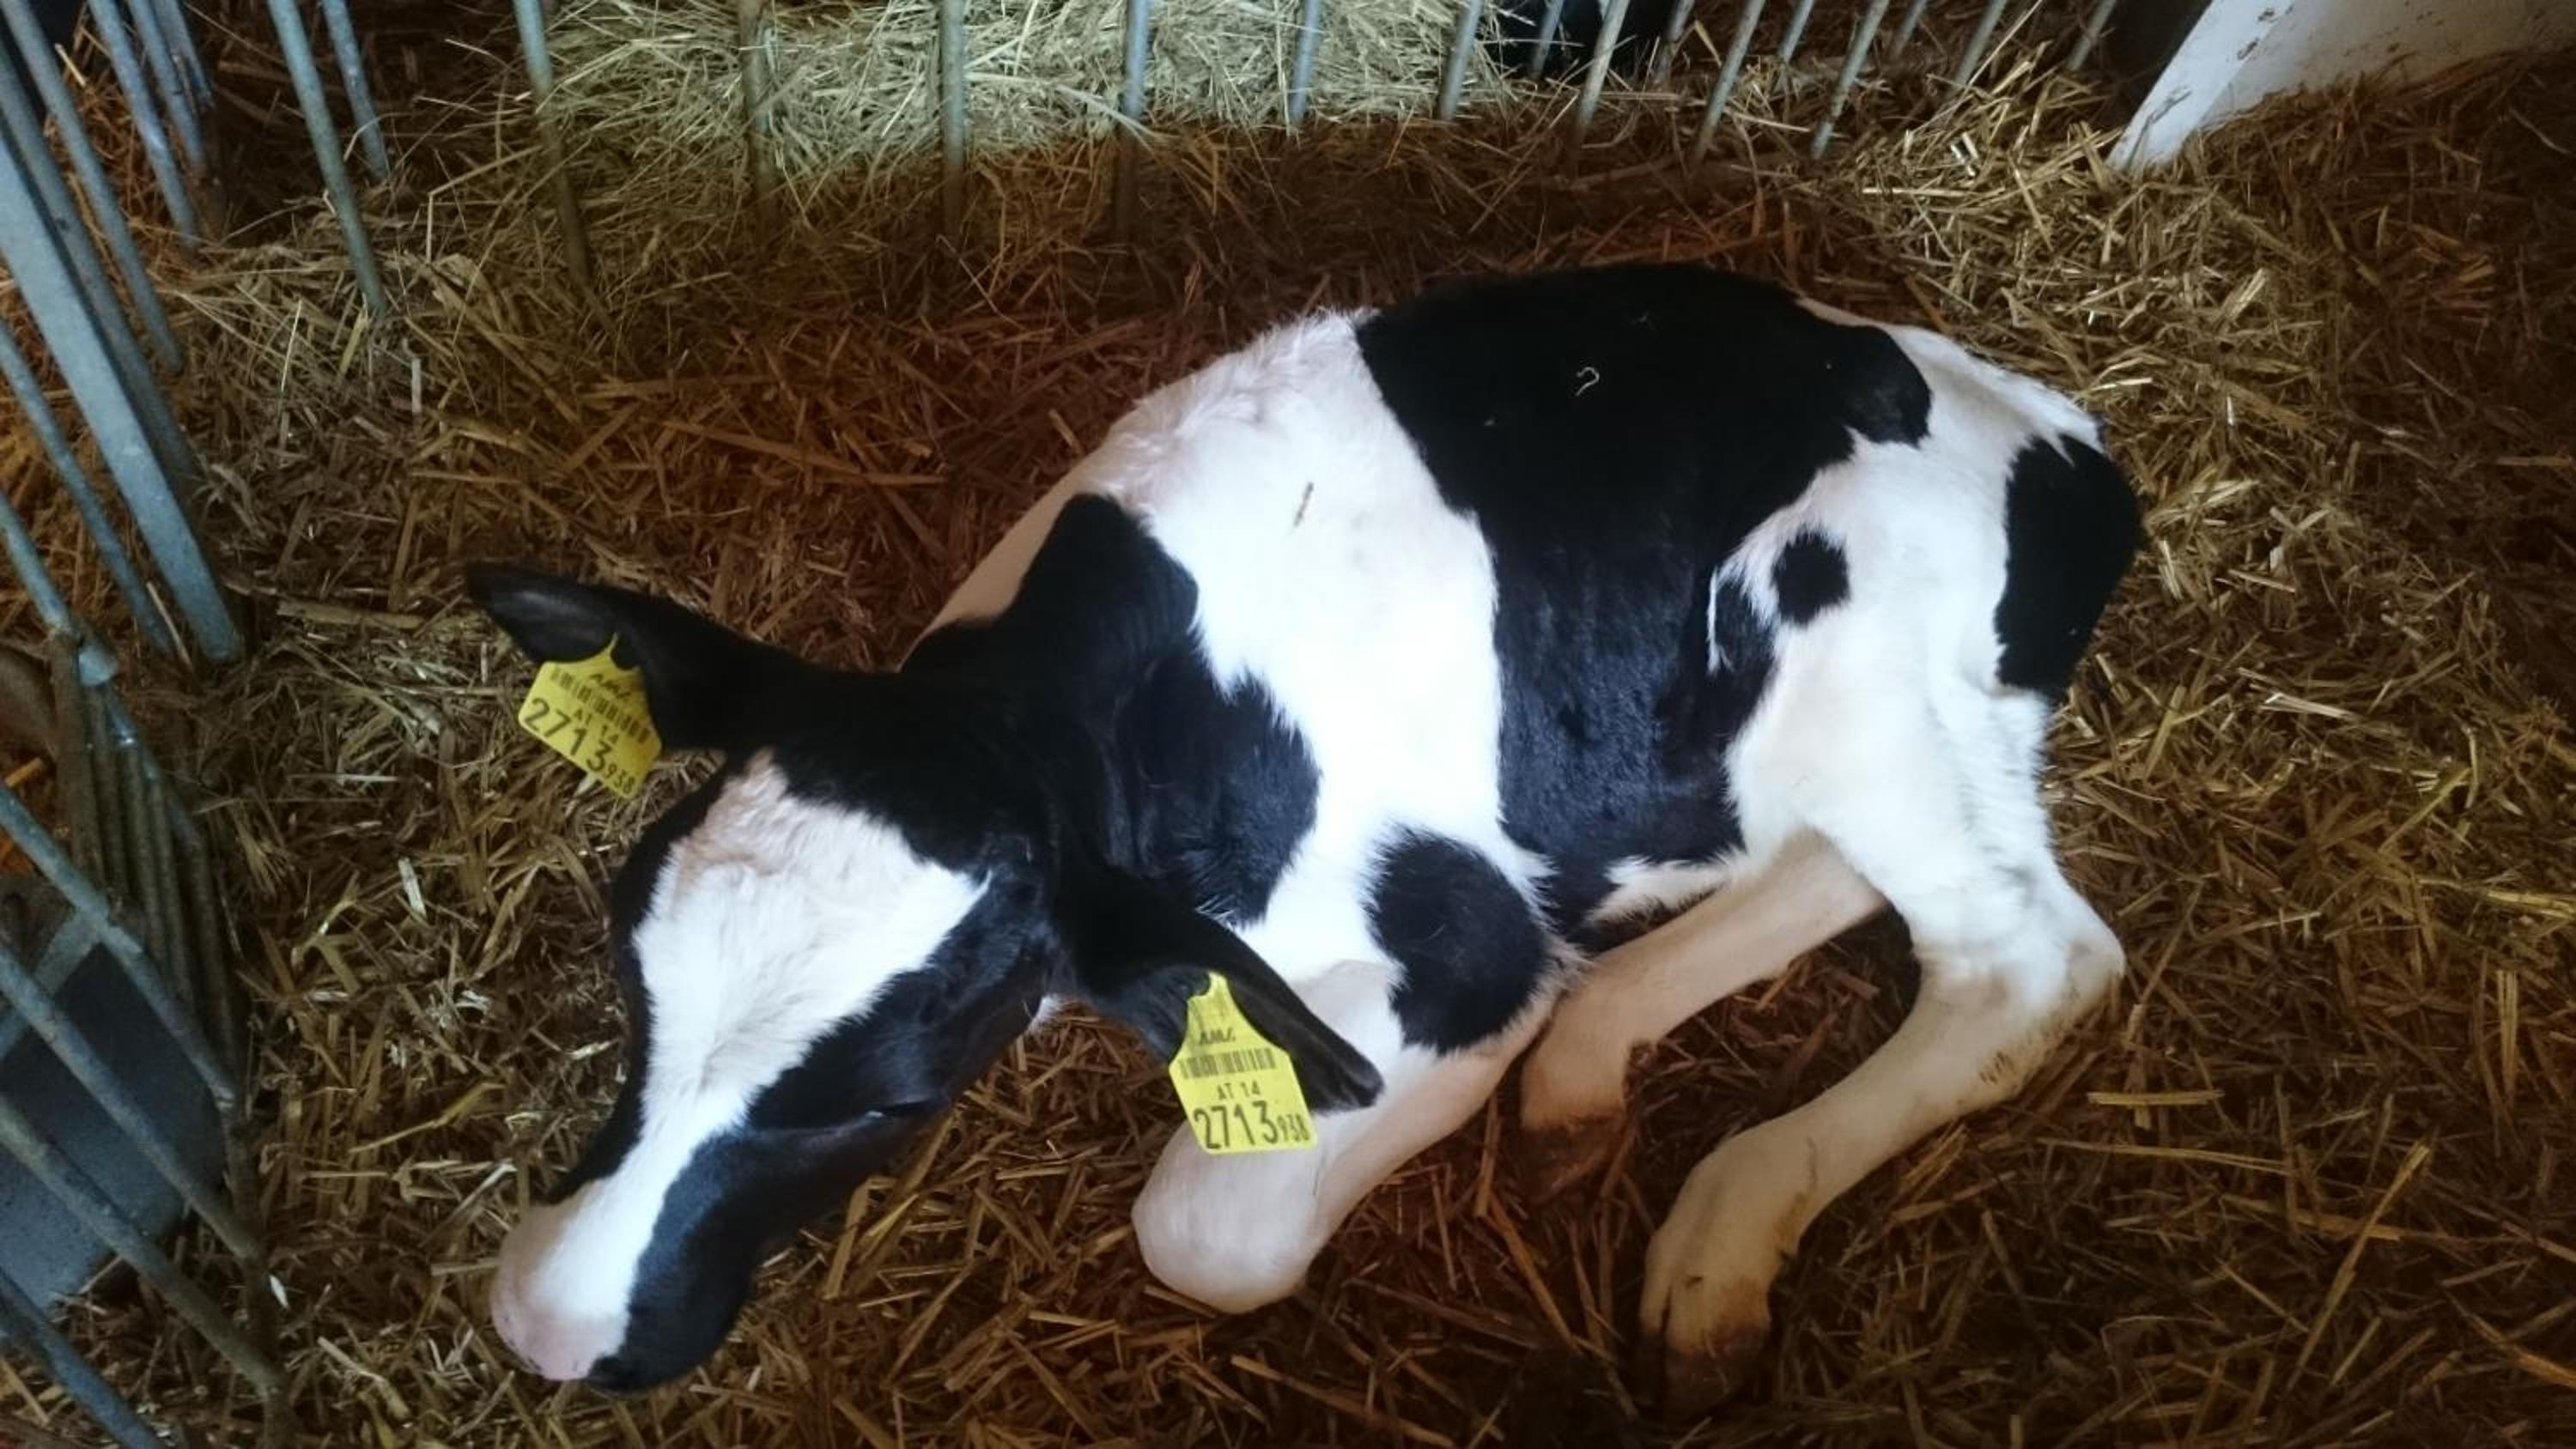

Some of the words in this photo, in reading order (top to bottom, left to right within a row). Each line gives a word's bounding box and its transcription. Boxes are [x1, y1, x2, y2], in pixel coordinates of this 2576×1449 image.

[523, 698, 613, 772] 2713
[606, 764, 635, 795] 938
[1216, 1082, 1235, 1100] AT
[1240, 1080, 1261, 1098] 14
[1193, 1100, 1279, 1149] 2713
